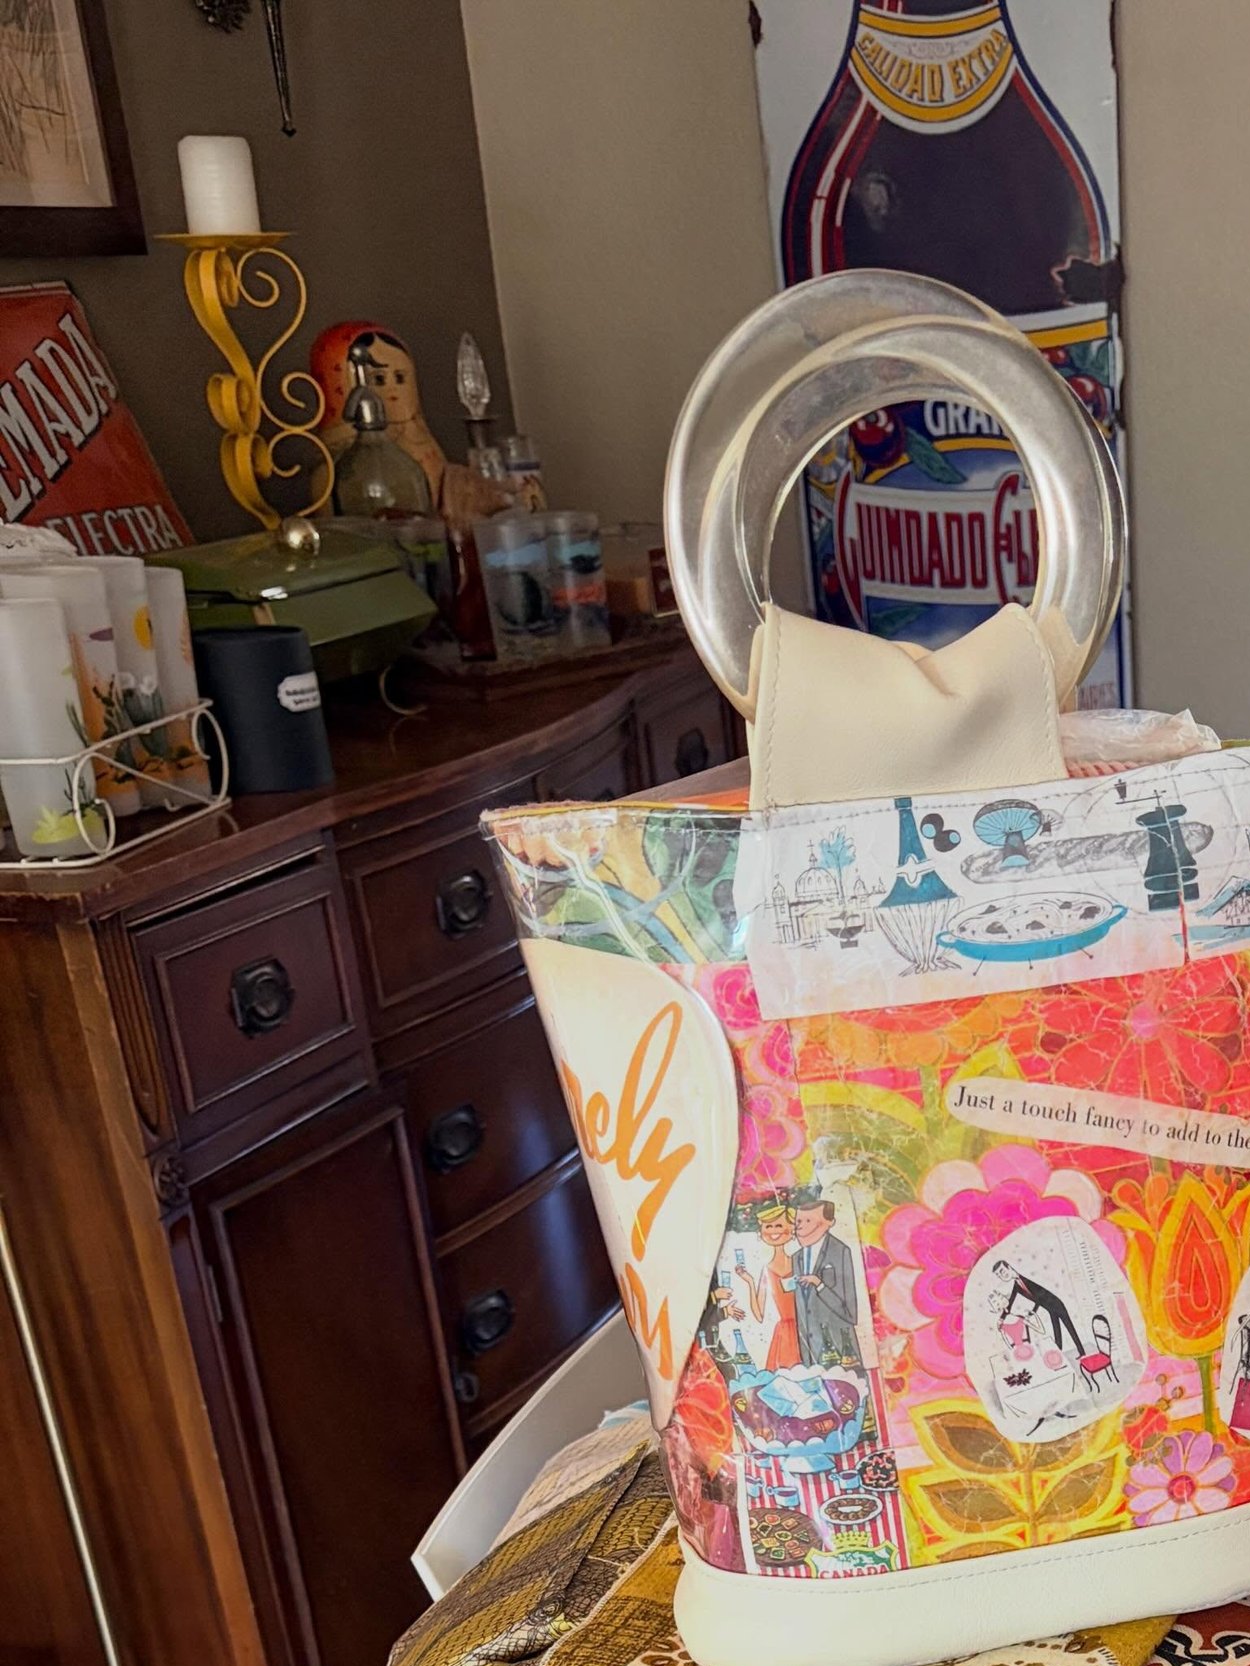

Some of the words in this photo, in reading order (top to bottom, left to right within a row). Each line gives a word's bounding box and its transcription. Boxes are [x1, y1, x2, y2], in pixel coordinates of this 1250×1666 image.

[858, 32, 944, 103] CALIDAD
[947, 28, 1009, 98] EXTRA
[954, 1085, 996, 1110] Just
[1002, 1100, 1013, 1113] a
[1021, 1100, 1077, 1123] touch
[1085, 1106, 1136, 1138] fancy
[1141, 1119, 1160, 1136] to
[1166, 1119, 1200, 1143] add
[1204, 1129, 1221, 1145] to
[819, 1565, 889, 1580] CANADA
